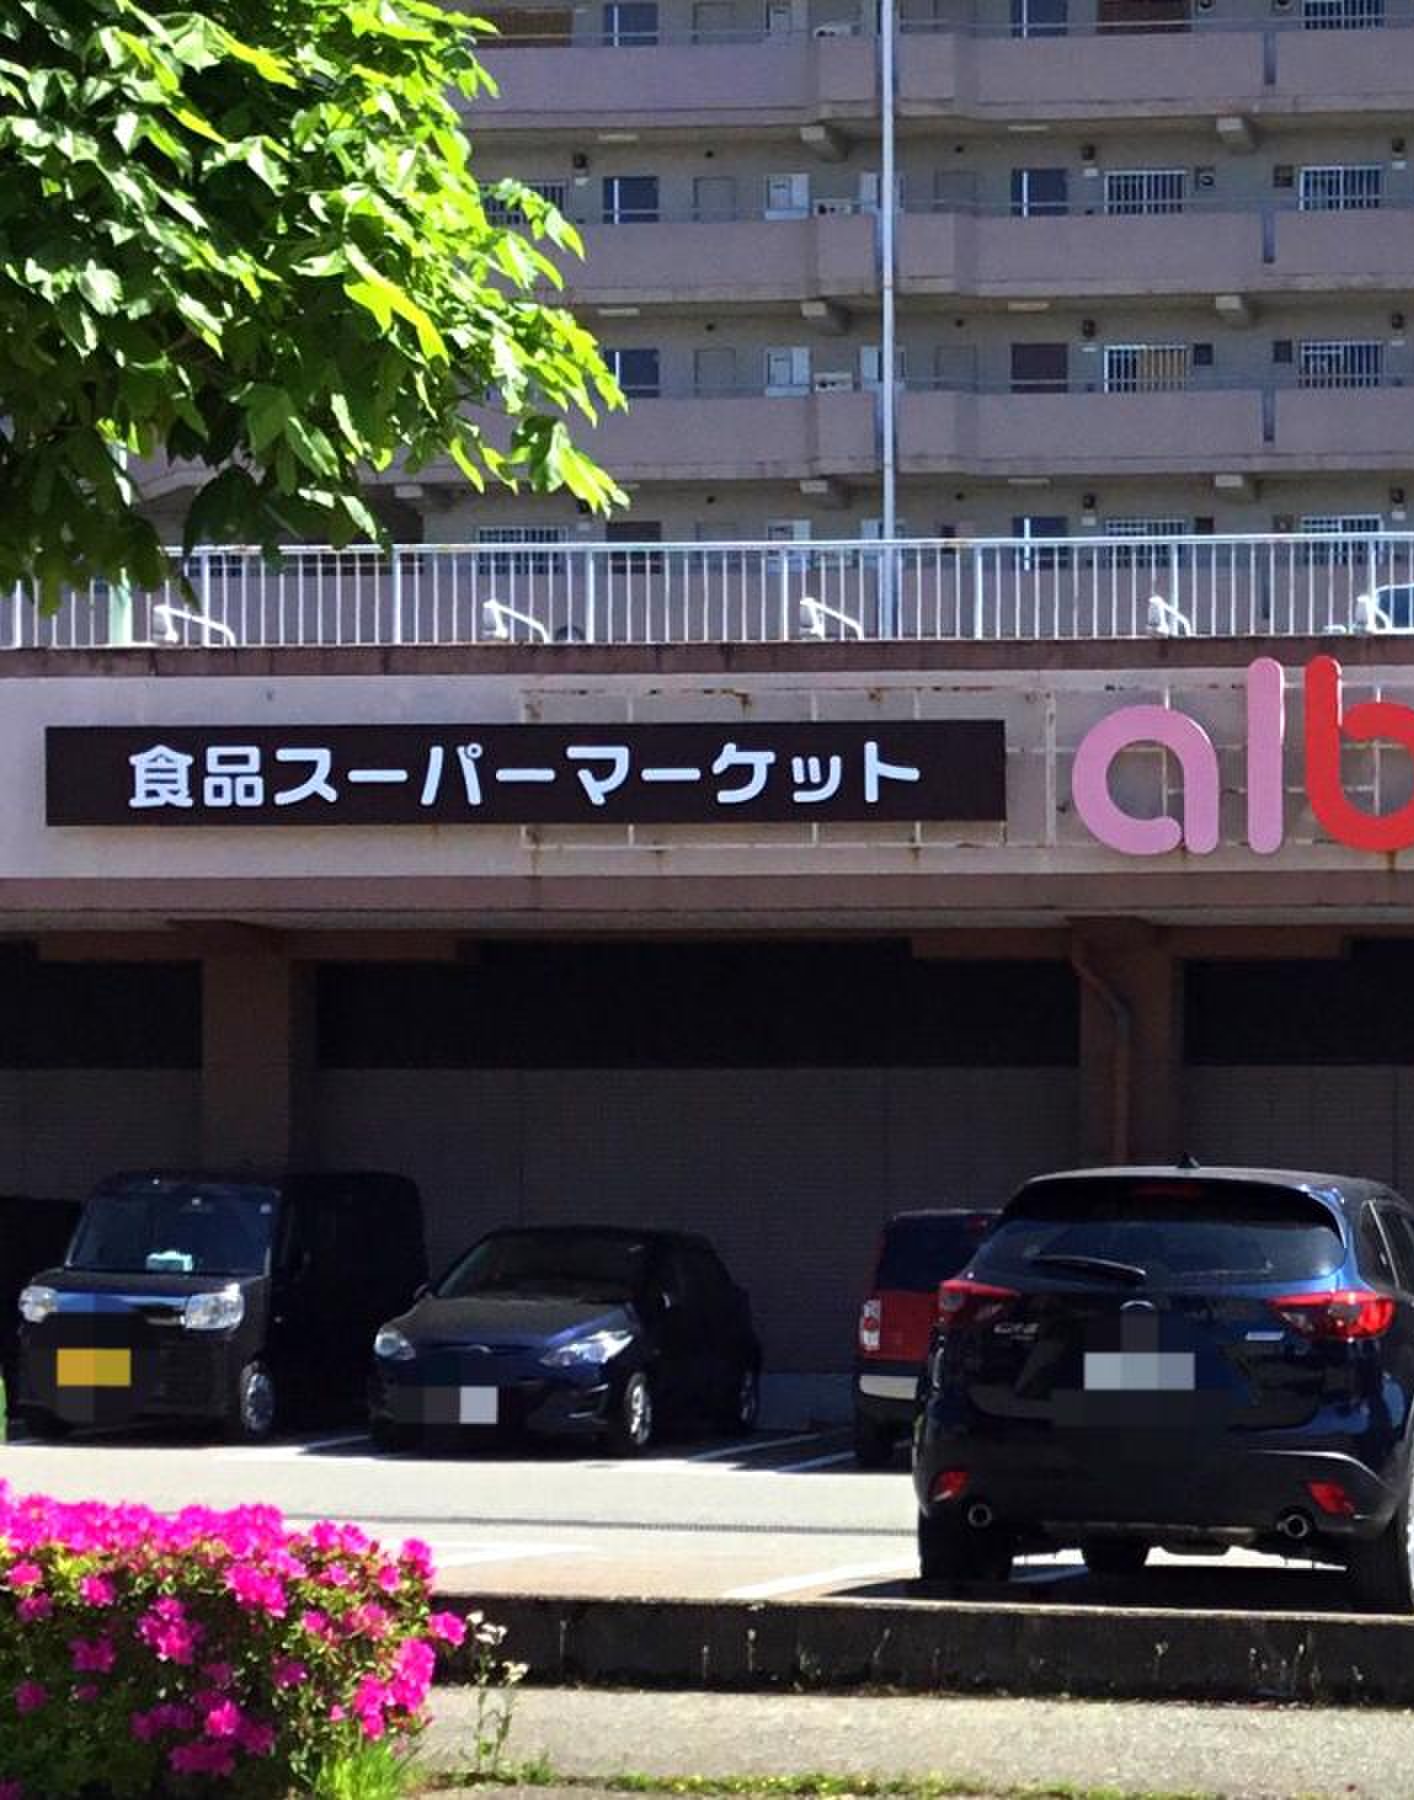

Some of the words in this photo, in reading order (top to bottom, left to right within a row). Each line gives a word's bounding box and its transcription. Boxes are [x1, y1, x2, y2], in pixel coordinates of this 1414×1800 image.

[128, 740, 921, 808] 食品スーパーマーケット
